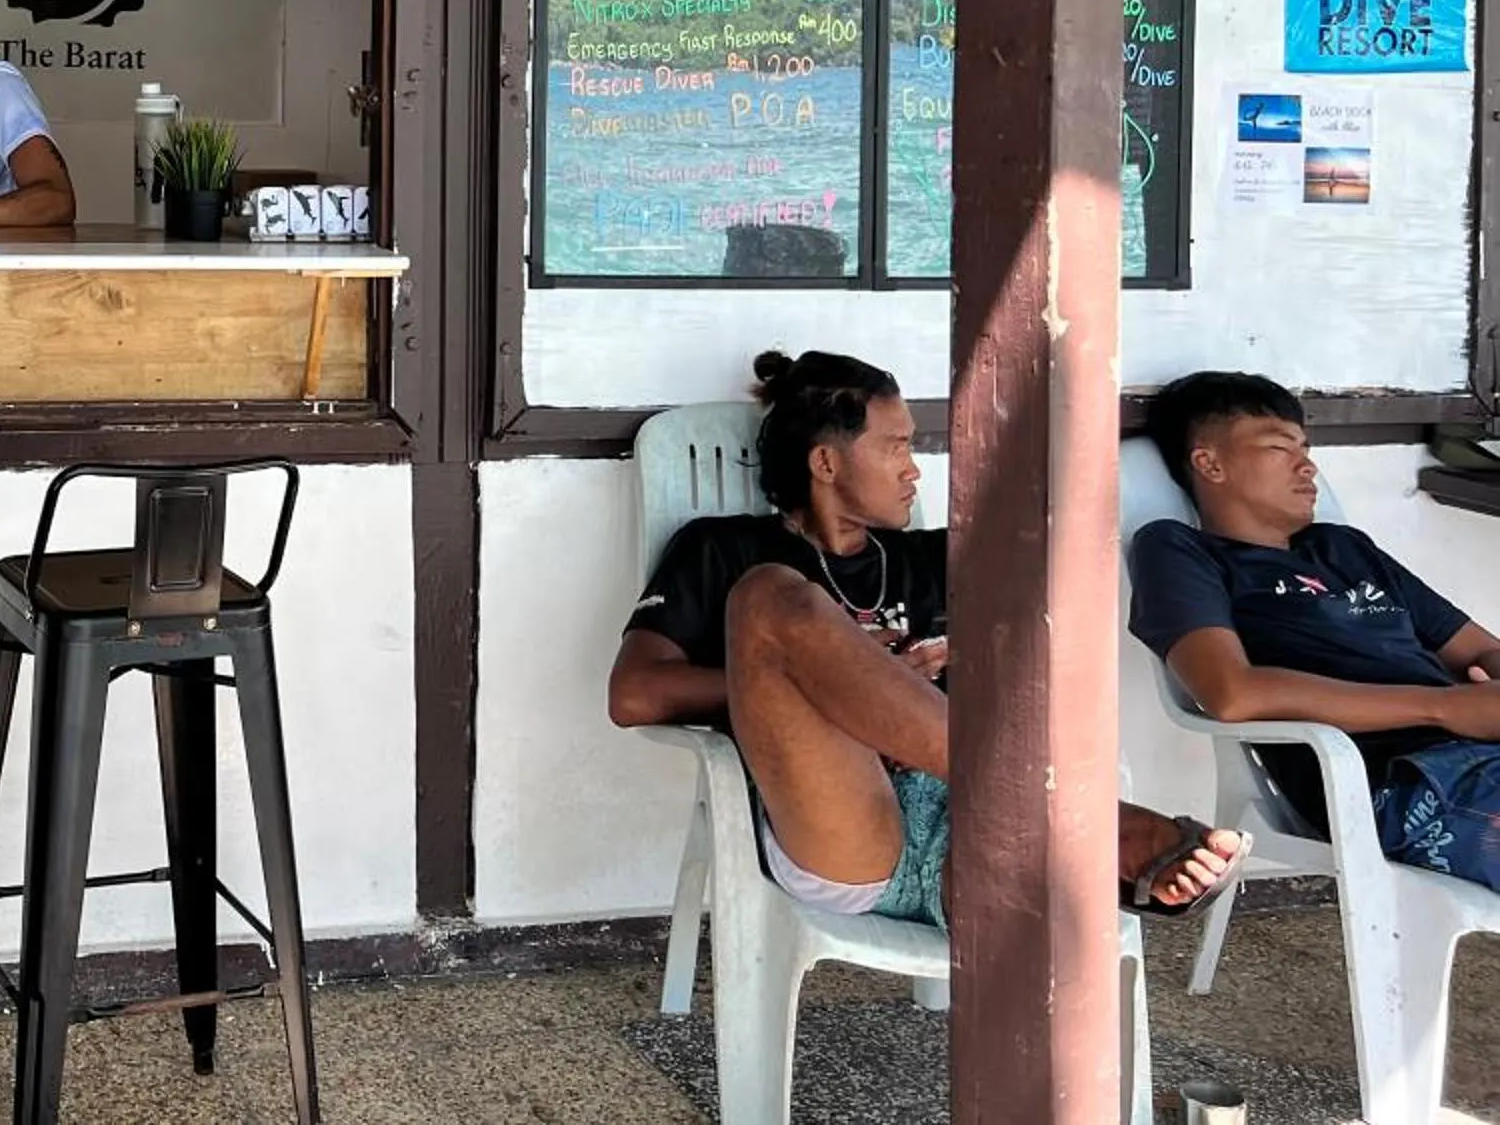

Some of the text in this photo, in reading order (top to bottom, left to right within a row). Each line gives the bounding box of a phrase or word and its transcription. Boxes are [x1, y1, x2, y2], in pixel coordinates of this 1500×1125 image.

[63, 41, 146, 69] Barat
[1318, 26, 1434, 57] RESORT
[571, 67, 645, 96] RESCUE
[654, 65, 716, 91] DIVER
